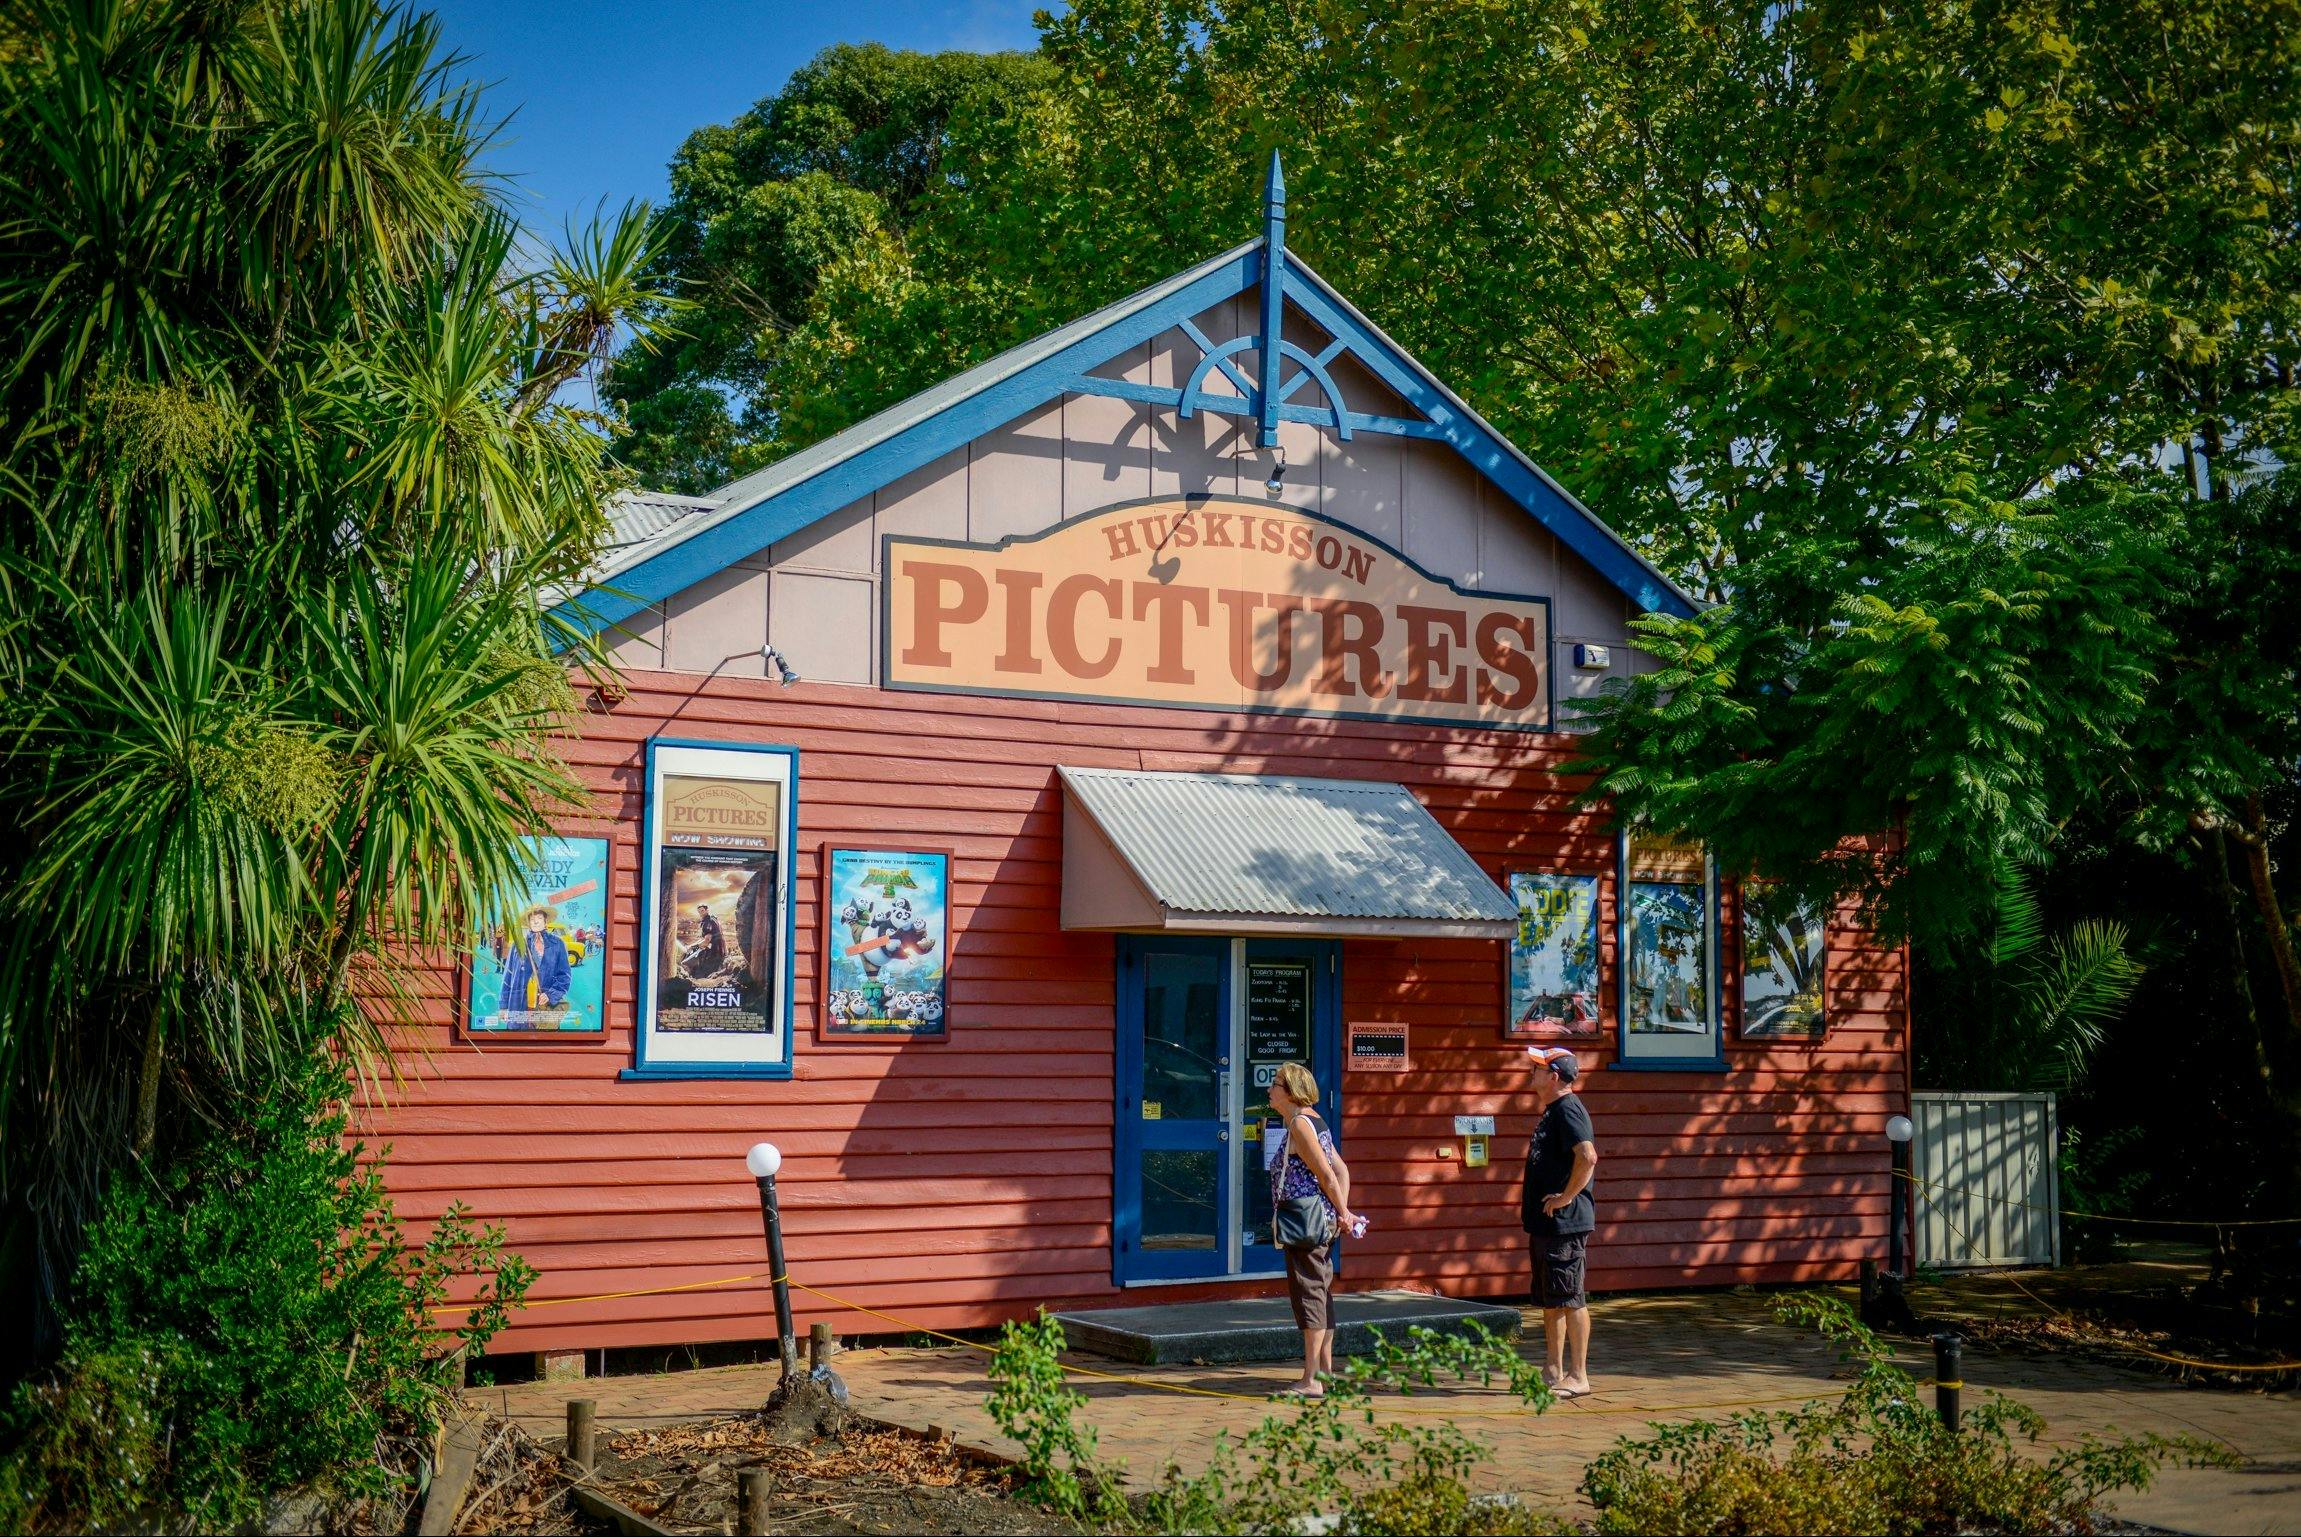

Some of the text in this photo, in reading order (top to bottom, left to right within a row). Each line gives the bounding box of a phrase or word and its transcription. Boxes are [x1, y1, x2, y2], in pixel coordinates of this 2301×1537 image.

[1101, 512, 1376, 586] HUSKISSON
[901, 559, 1539, 711] PICTURES
[690, 789, 750, 806] HUSKISSON
[673, 806, 767, 826] PICTURES
[671, 833, 767, 847] NOW SHOWING
[1635, 848, 1698, 863] PICTURES
[532, 860, 574, 874] ADY
[687, 992, 741, 1007] RISEN
[1256, 1068, 1277, 1084] OP
